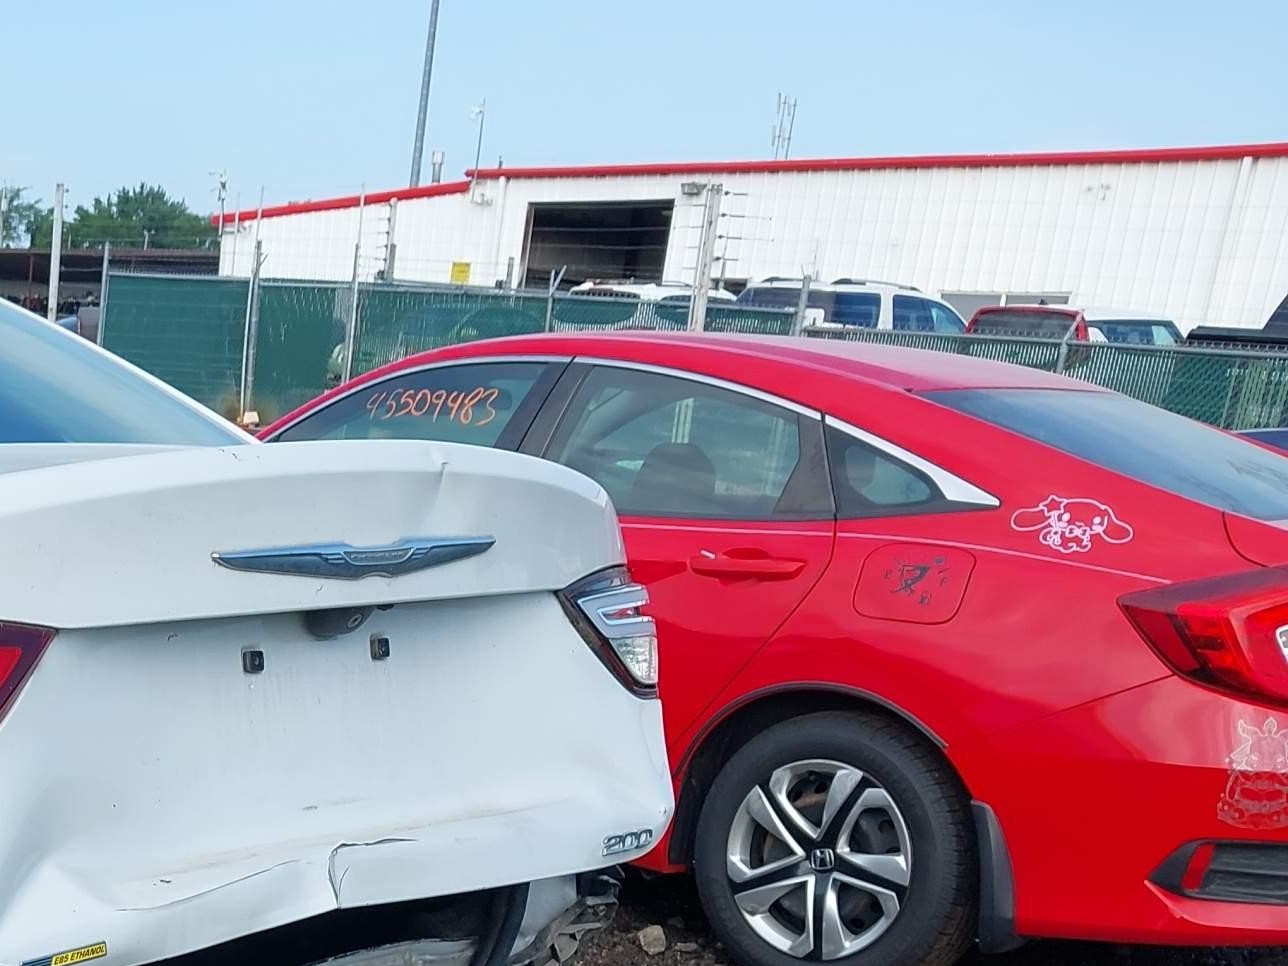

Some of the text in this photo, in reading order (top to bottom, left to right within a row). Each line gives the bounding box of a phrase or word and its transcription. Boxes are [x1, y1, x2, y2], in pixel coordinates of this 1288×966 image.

[366, 387, 499, 425] 45509483
[602, 829, 653, 856] 200
[70, 946, 105, 961] ETHANOL
